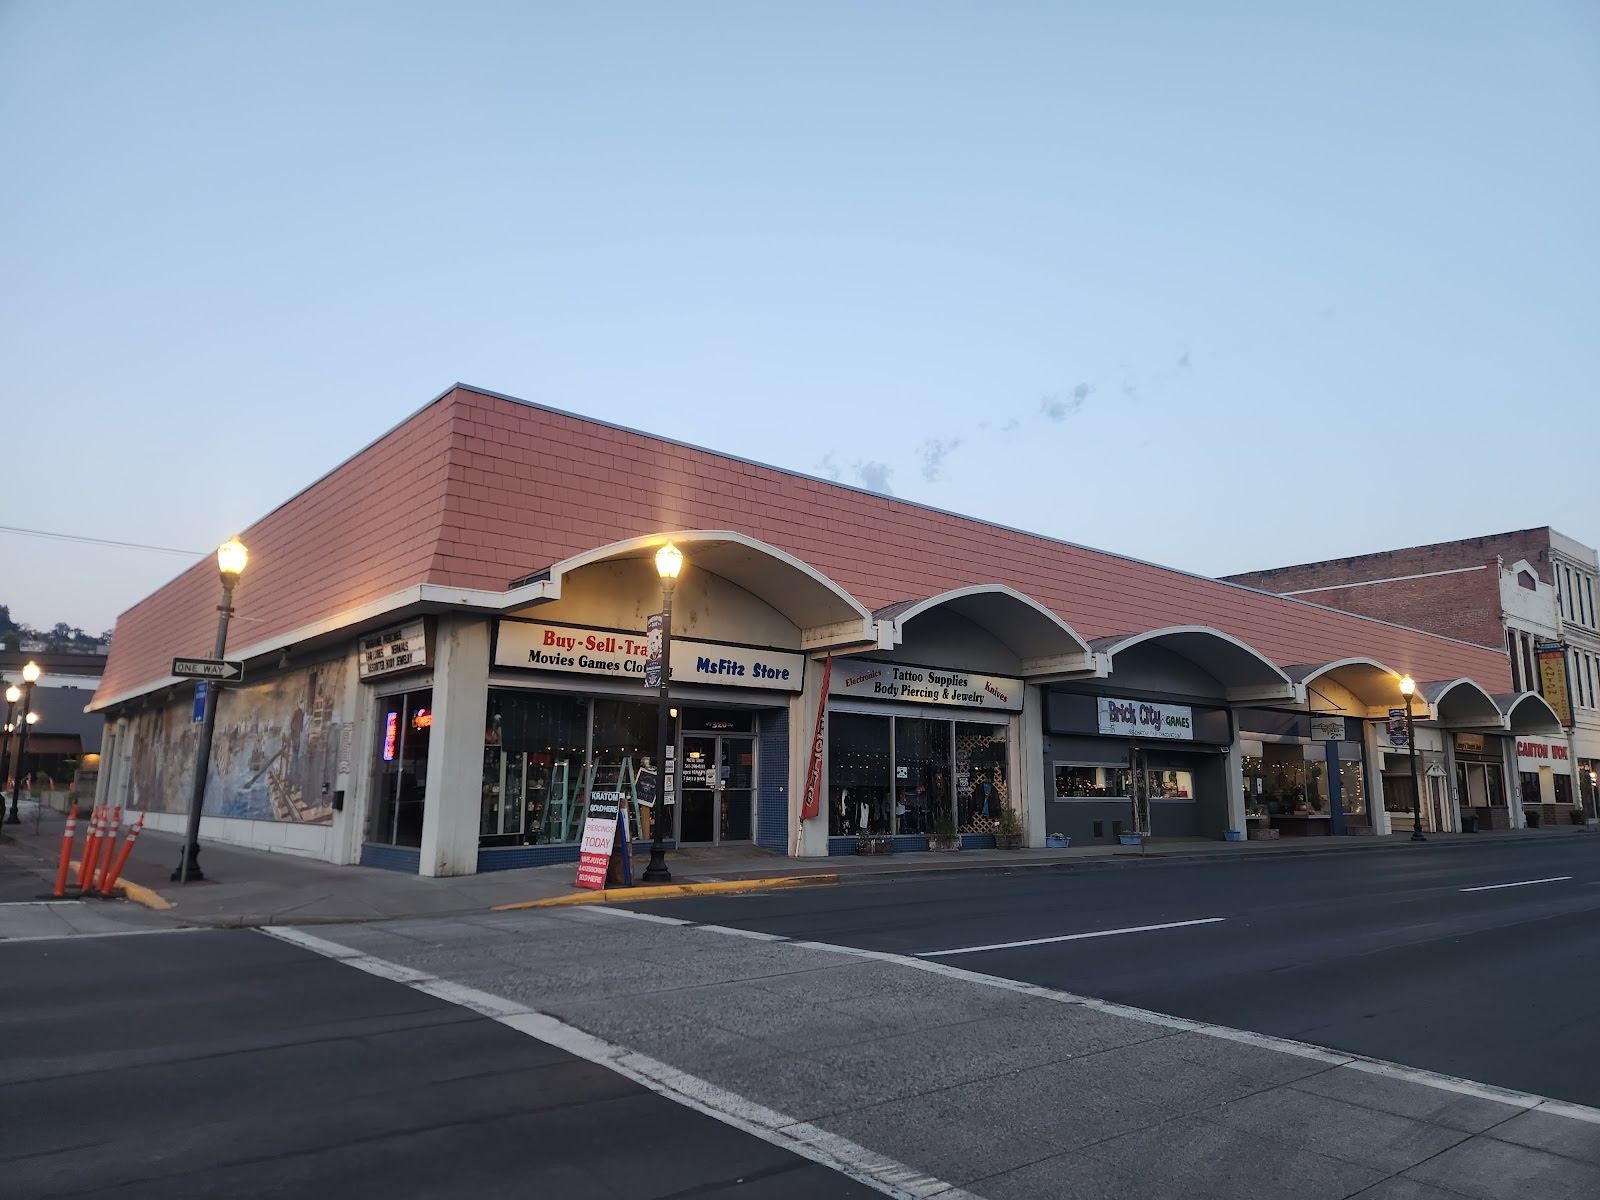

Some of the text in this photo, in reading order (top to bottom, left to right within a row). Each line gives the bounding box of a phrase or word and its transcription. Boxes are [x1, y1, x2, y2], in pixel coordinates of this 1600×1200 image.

[177, 663, 223, 674] ONE WAY
[528, 649, 575, 667] Movies
[578, 655, 620, 671] Games
[696, 656, 790, 680] MsFitz Store
[845, 669, 882, 687] Electronics
[892, 668, 968, 688] Tattoo Supplies
[874, 681, 985, 705] Body Piercing & Jewelry
[984, 681, 1008, 703] Knives
[711, 721, 728, 729] 320
[1108, 701, 1137, 726] Brick
[1139, 704, 1162, 731] City
[1165, 716, 1190, 729] GAMES
[1516, 741, 1569, 760] CANTON WOK
[591, 791, 619, 802] KRATOM
[603, 805, 618, 814] HERE
[586, 824, 614, 834] PIERCINGS
[585, 836, 611, 849] TODAY
